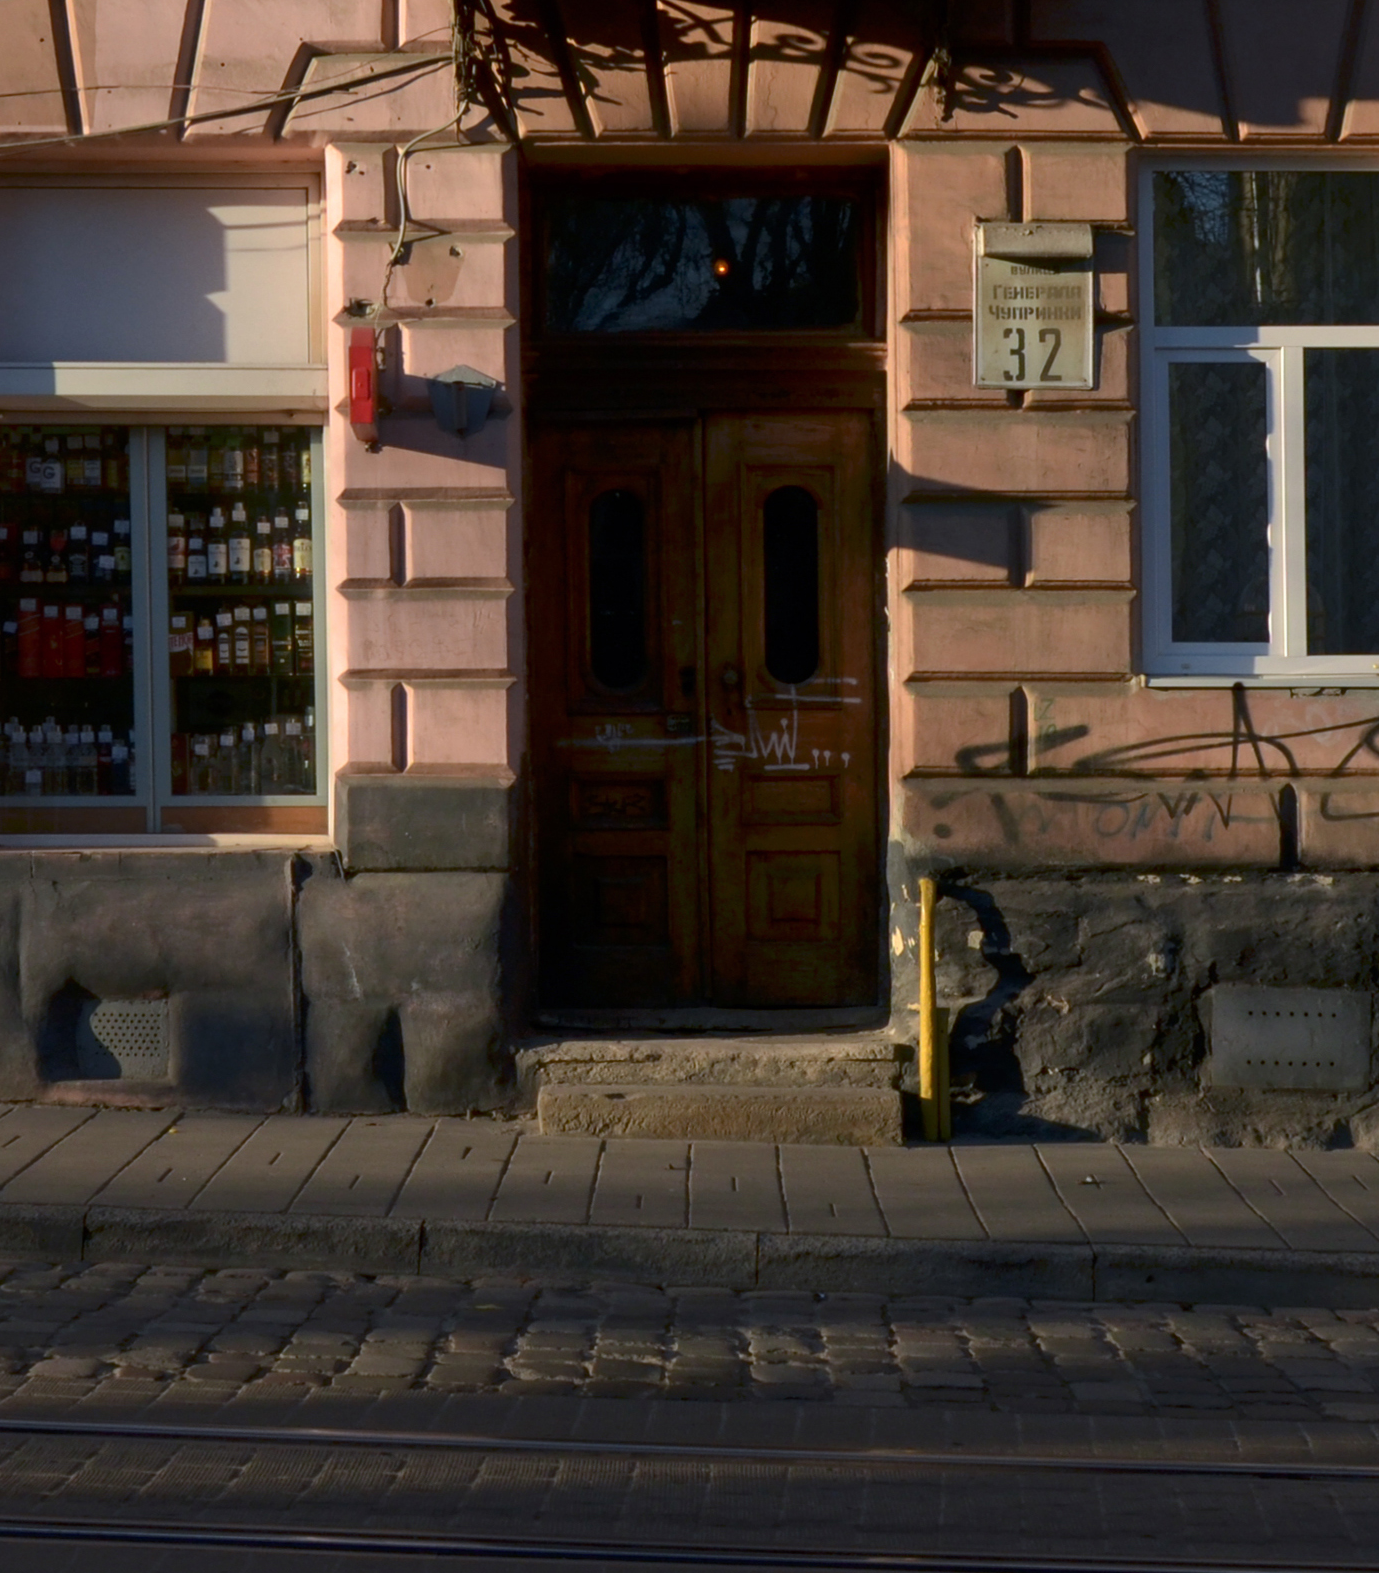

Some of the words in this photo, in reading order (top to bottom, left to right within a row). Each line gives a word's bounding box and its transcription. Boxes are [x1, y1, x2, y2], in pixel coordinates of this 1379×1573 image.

[993, 285, 1082, 300] ГЕНЕРАЛА
[989, 305, 1082, 321] ЧУПРИНКИ
[1003, 327, 1063, 382] 32
